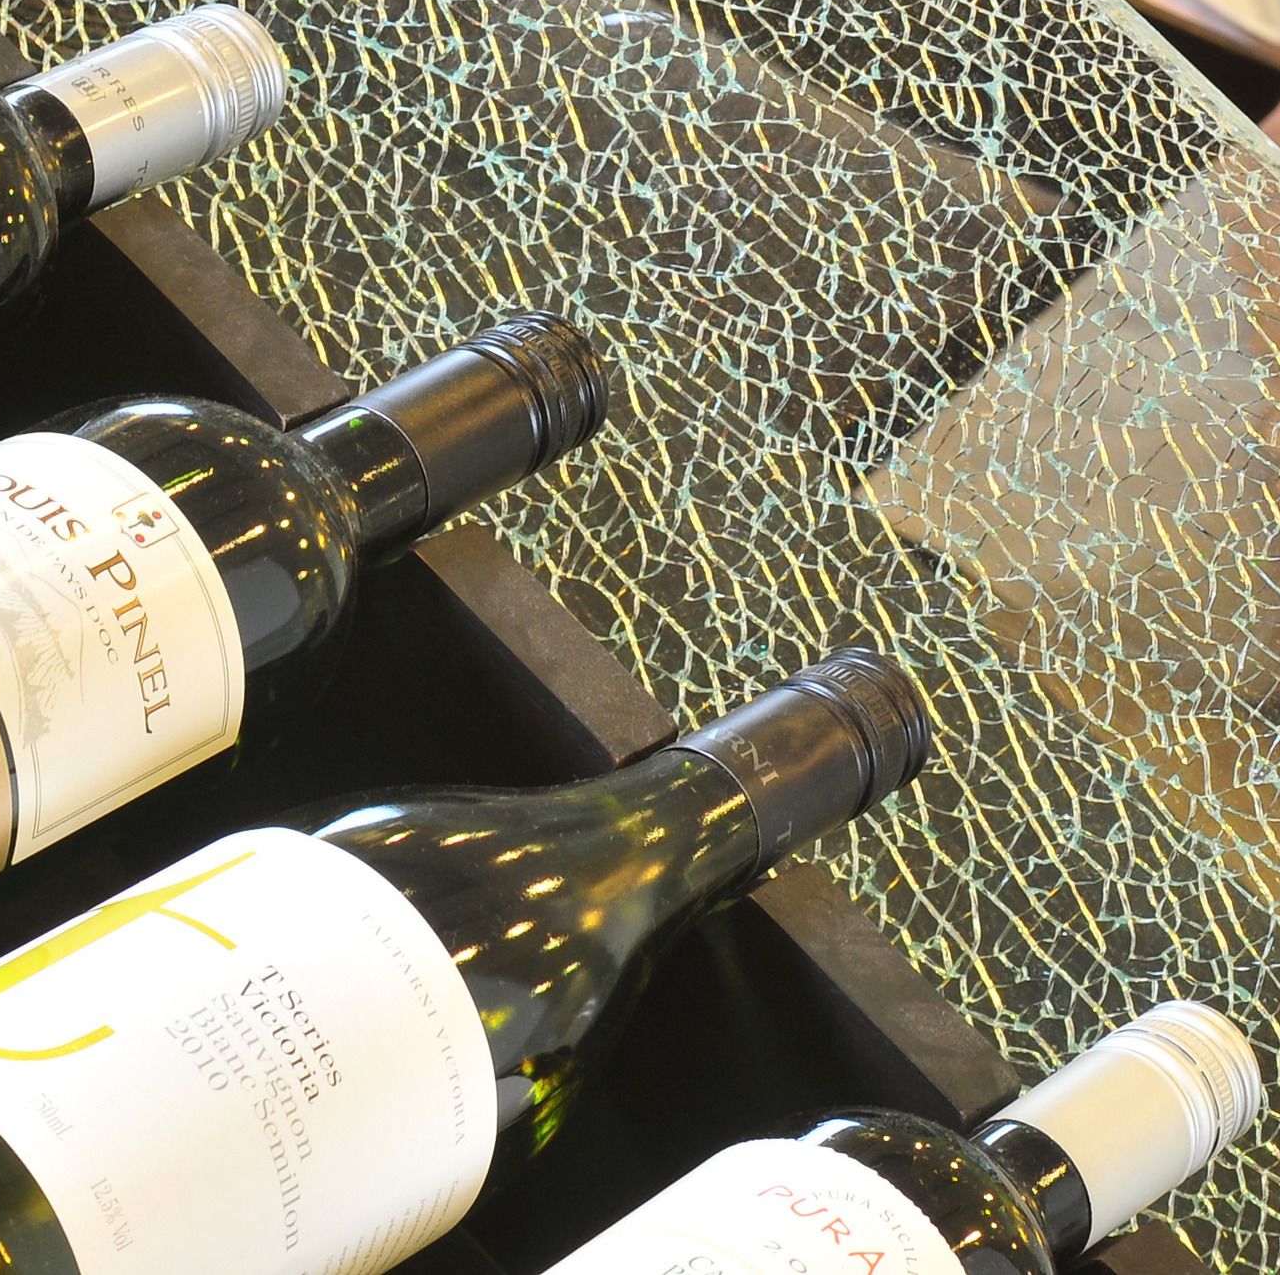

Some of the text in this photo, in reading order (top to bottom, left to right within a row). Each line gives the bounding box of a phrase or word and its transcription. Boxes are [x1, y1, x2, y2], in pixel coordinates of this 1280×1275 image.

[84, 549, 171, 736] PINEL
[163, 1019, 230, 1092] 2010
[211, 991, 313, 1164] Sauvignon
[239, 978, 321, 1106] Victoria
[261, 964, 343, 1089] T Series
[436, 1026, 466, 1146] VICTORIA
[189, 1006, 302, 1253] Blanc Semillon
[90, 1177, 135, 1252] 12.5% Vol
